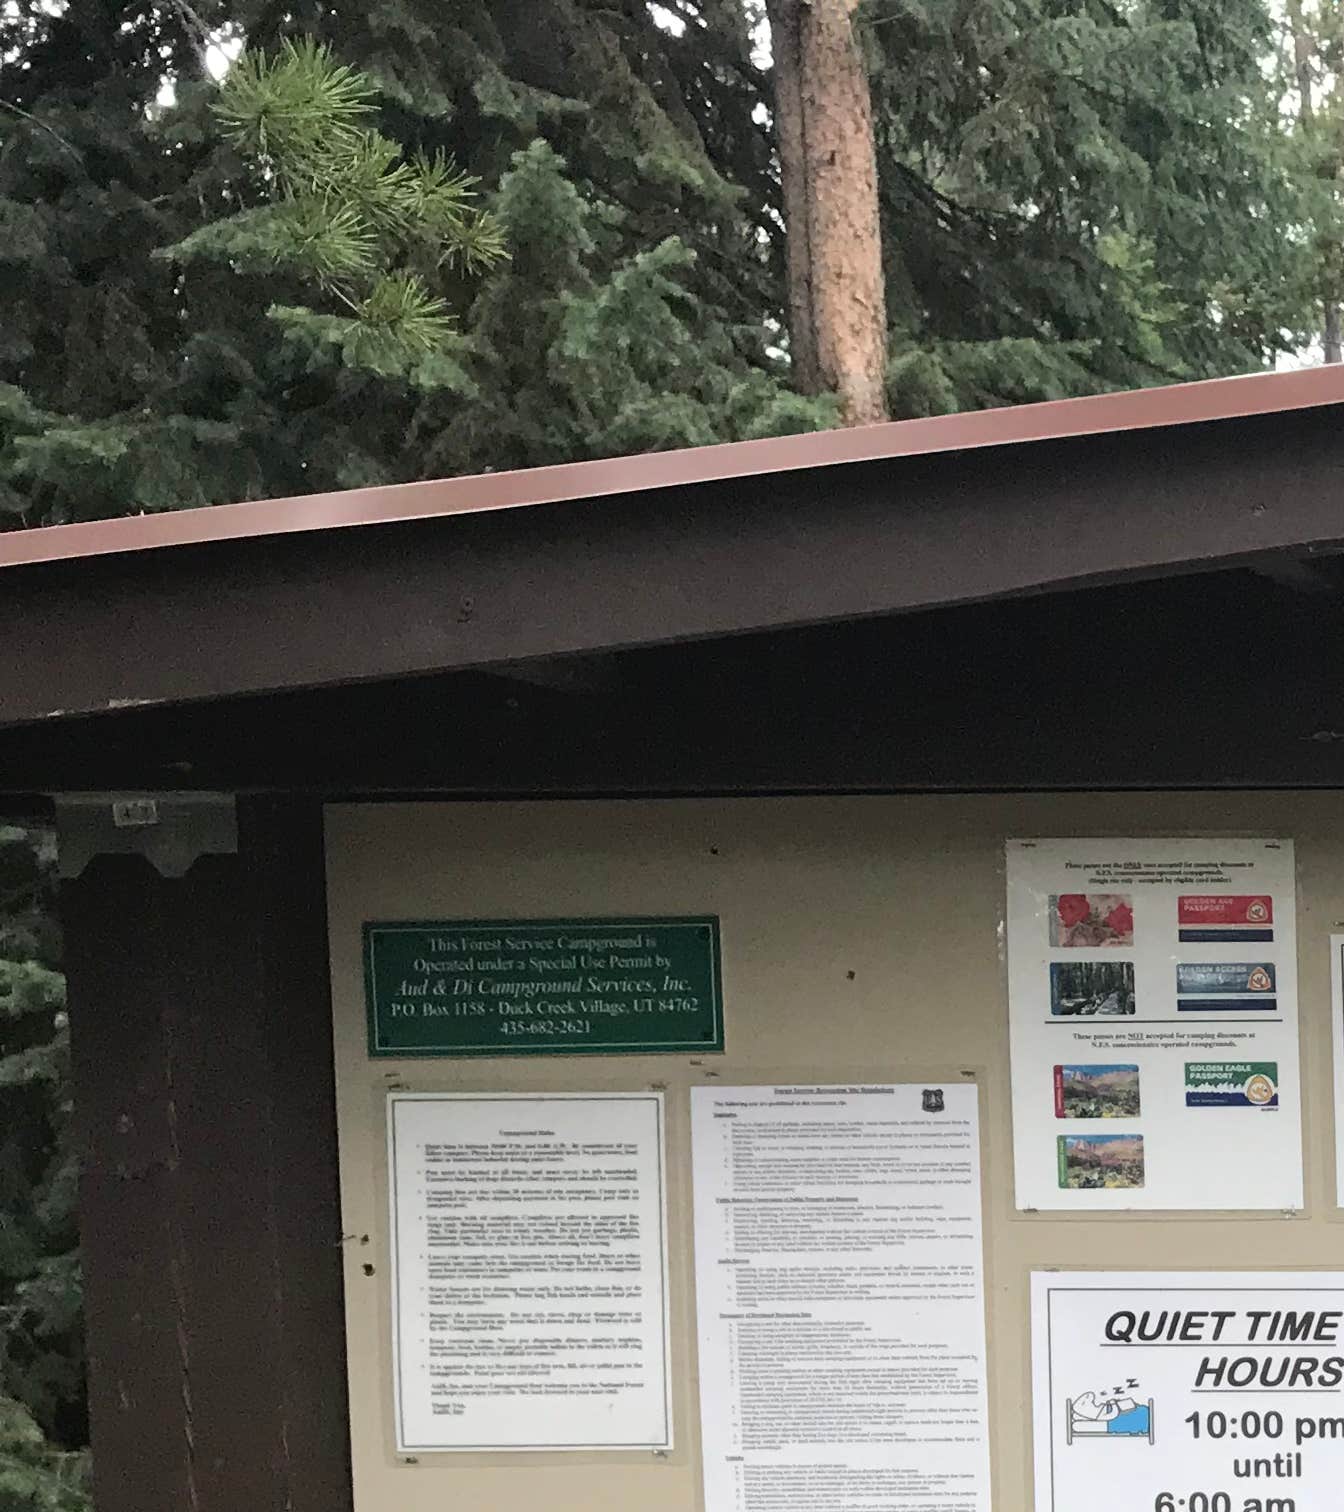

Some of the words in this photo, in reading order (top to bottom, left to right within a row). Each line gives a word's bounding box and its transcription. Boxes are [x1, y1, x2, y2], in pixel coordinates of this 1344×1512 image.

[478, 976, 582, 997] Campground
[1104, 1310, 1236, 1343] QUIET
[1245, 1310, 1343, 1341] TIME
[1194, 1356, 1344, 1386] HOURS
[1184, 1410, 1283, 1438] 10:00
[1233, 1452, 1301, 1477] until
